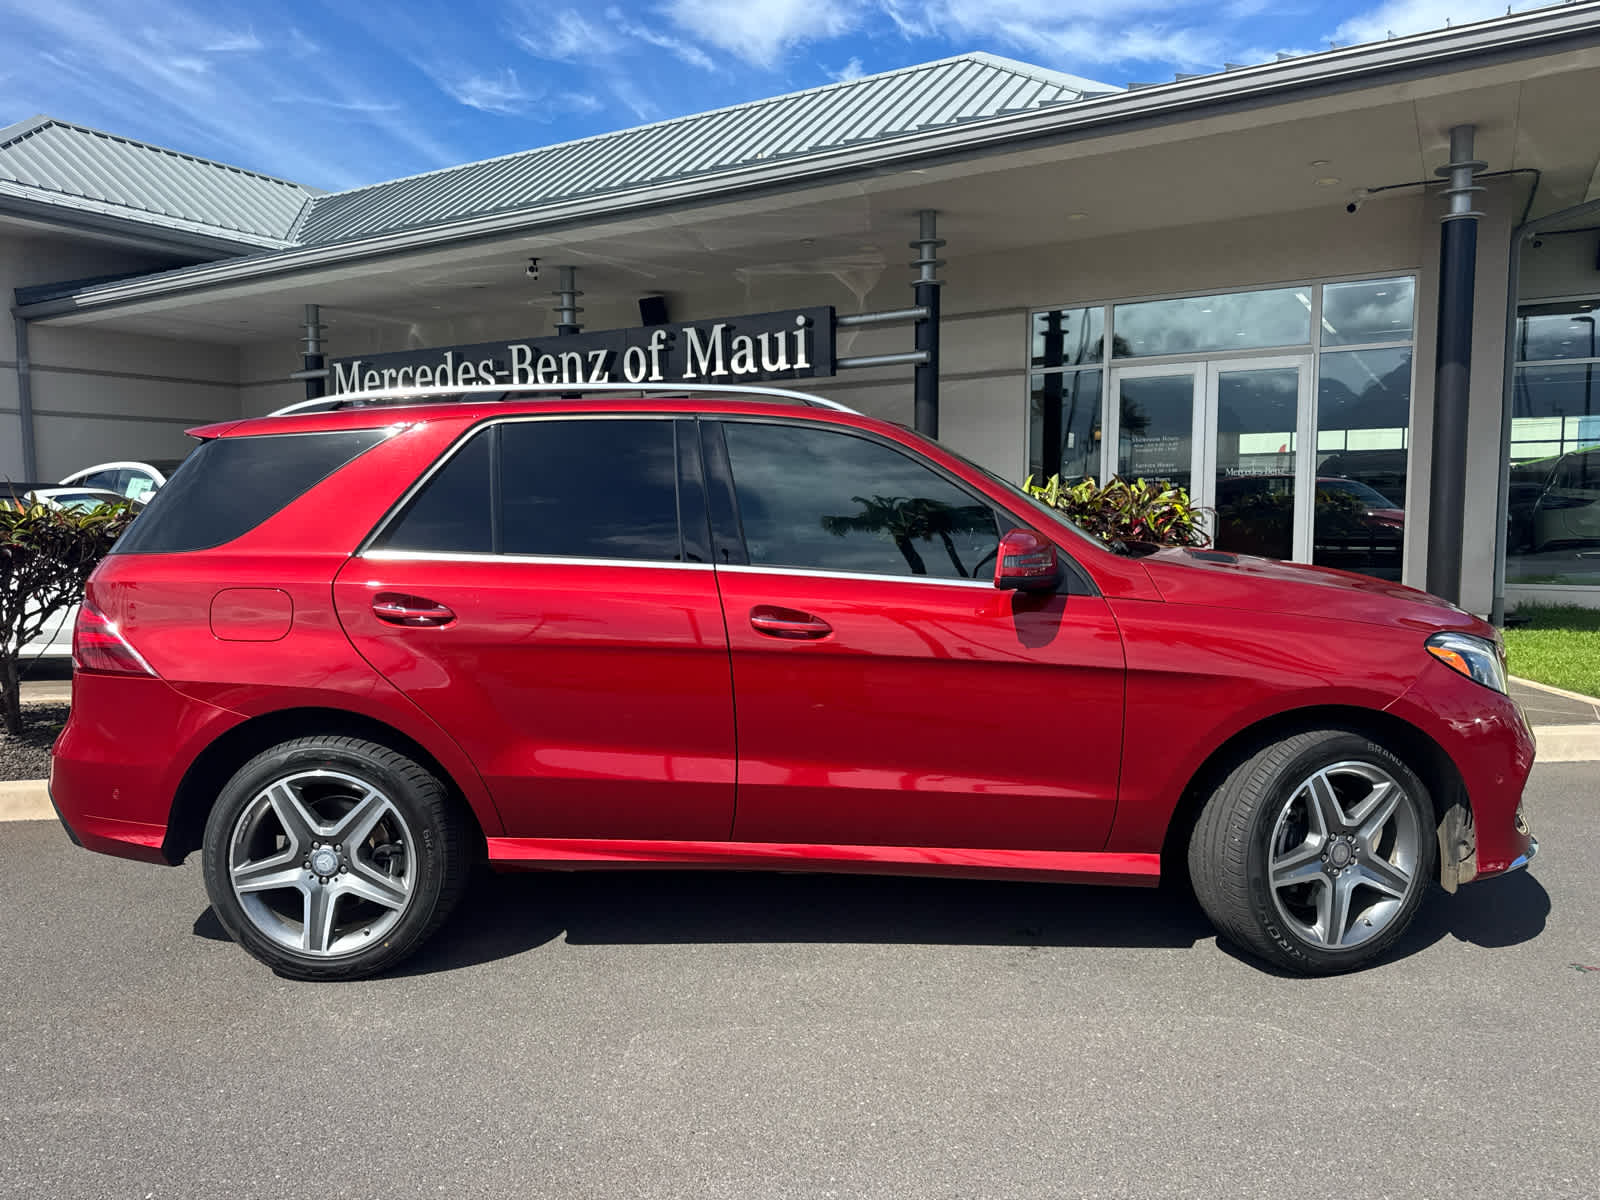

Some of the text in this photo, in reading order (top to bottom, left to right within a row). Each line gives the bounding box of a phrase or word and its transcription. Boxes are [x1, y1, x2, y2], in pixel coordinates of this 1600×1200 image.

[332, 314, 811, 396] Mercedes-Benz of Maui
